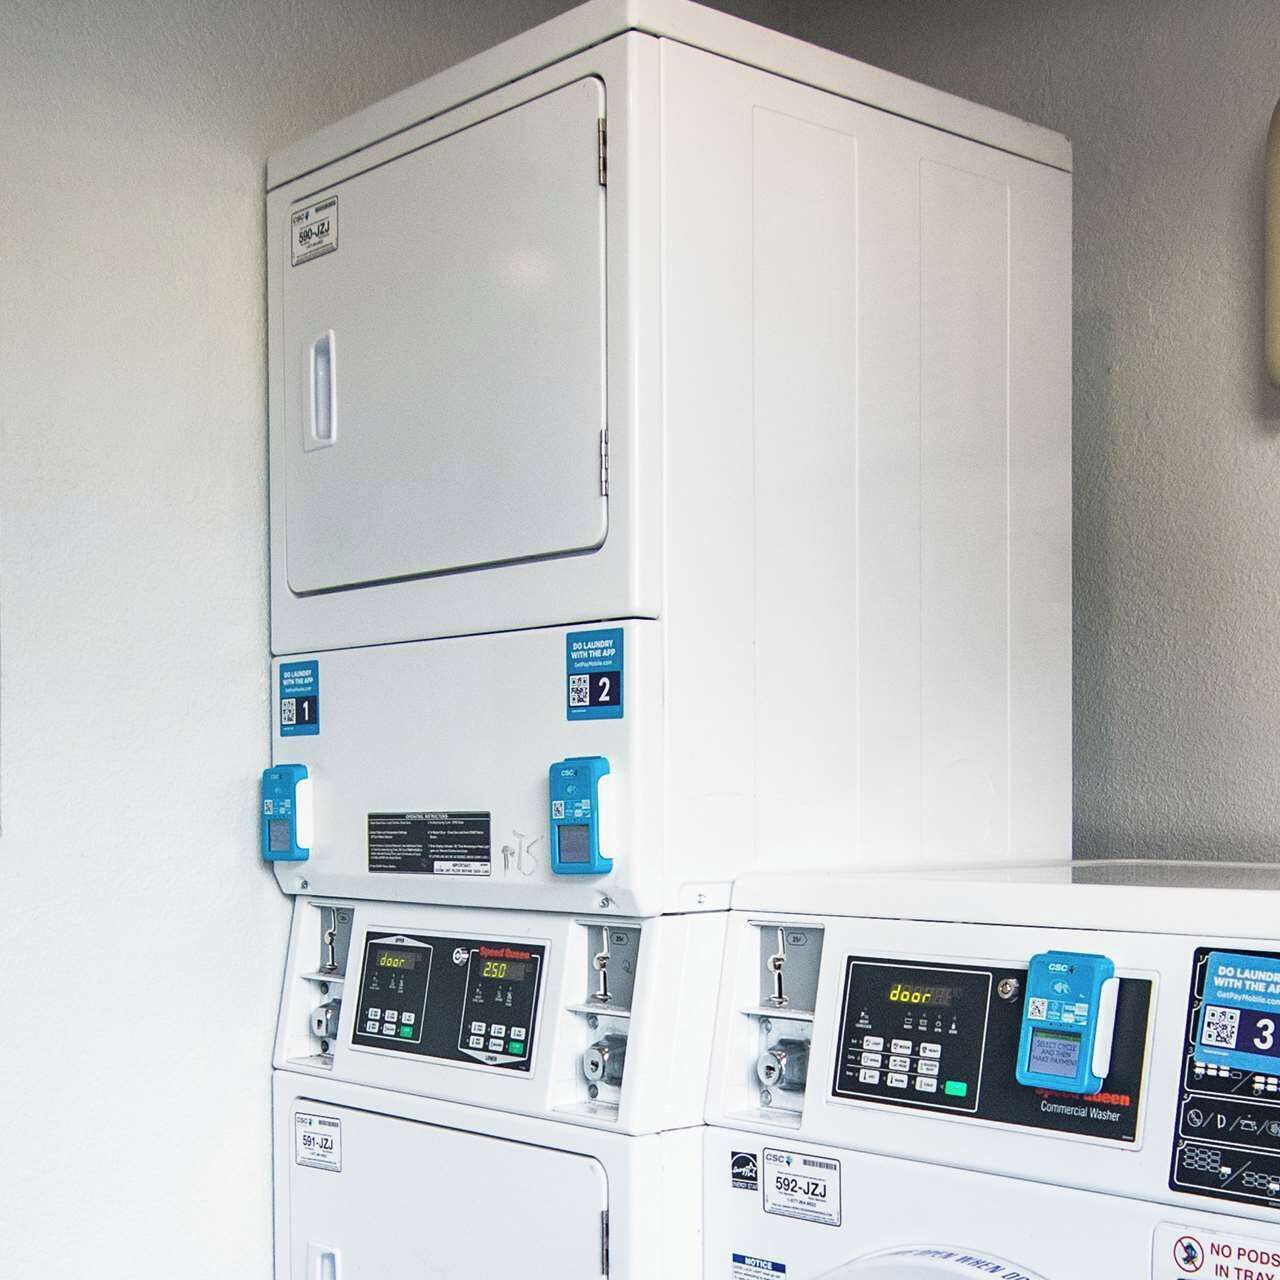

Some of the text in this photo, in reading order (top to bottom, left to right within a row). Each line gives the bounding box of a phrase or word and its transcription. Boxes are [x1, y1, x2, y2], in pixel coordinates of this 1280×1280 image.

[299, 220, 330, 243] 590-JZJ
[583, 640, 614, 649] LAUNDRY
[570, 648, 616, 659] WITH THE APP
[599, 677, 610, 702] 2
[302, 700, 309, 721] 1
[380, 951, 405, 968] door
[1048, 963, 1068, 972] CSC
[1218, 966, 1235, 976] DO
[1214, 976, 1242, 989] WITH
[1244, 980, 1266, 992] THE
[889, 984, 931, 1004] door
[1253, 1018, 1276, 1050] 3
[1041, 1100, 1121, 1122] Commercial Washer
[303, 1134, 333, 1151] 591-JZJ
[766, 1153, 785, 1163] CSC
[776, 1176, 827, 1198] 592-JZJ
[1210, 1242, 1280, 1267] NO PODS
[744, 1257, 773, 1270] NOTICE
[955, 1255, 1005, 1274] WHEN
[1215, 1264, 1229, 1278] IN
